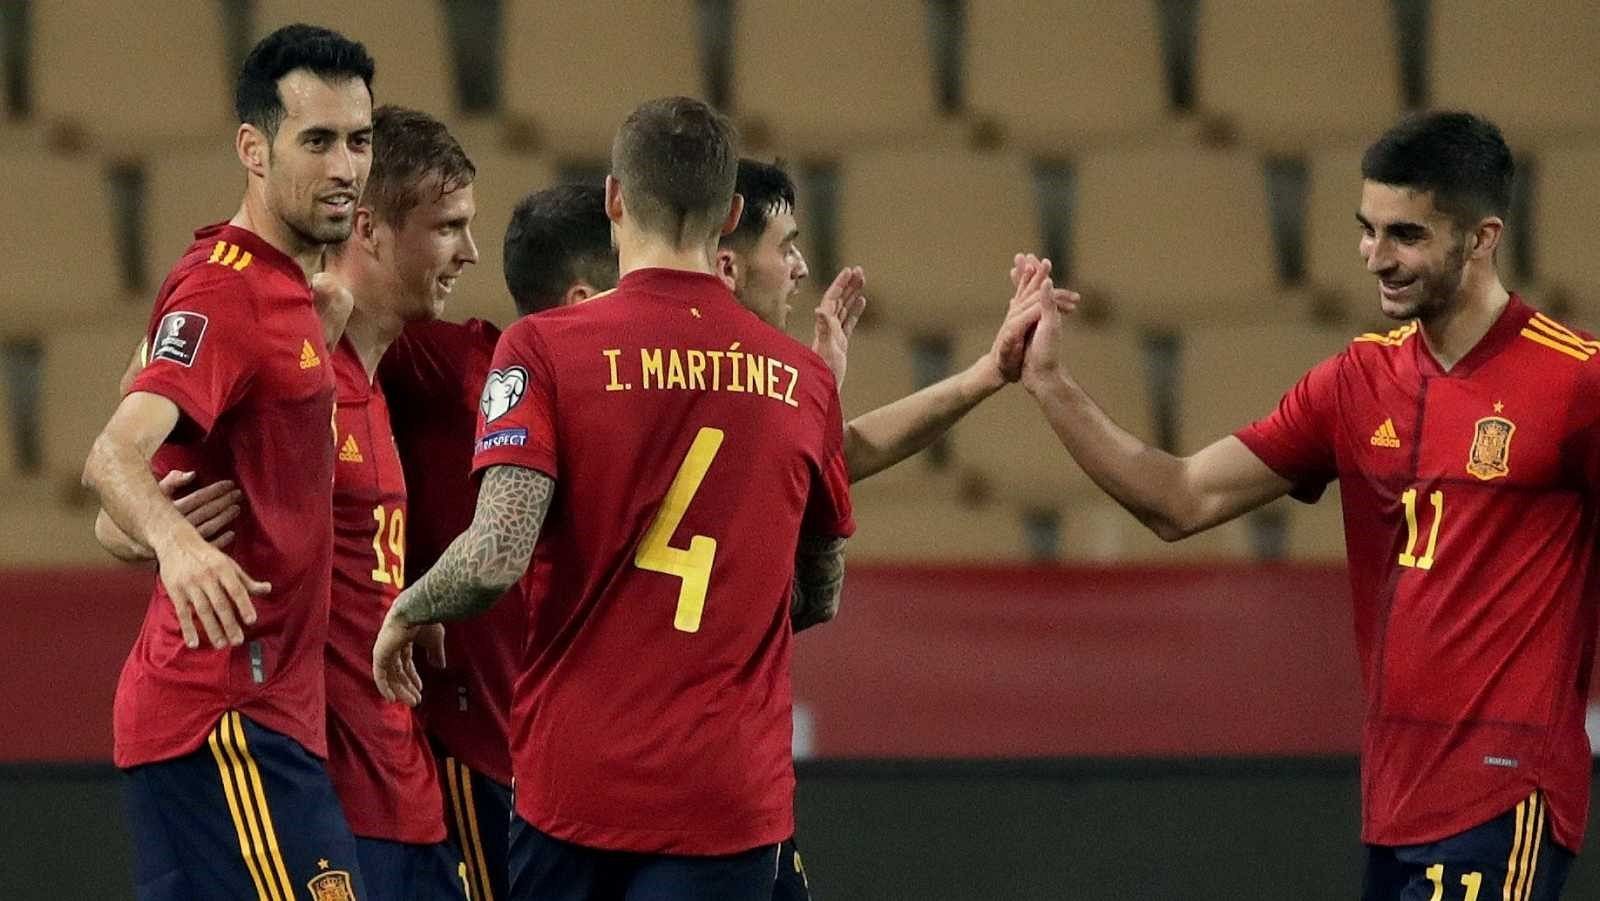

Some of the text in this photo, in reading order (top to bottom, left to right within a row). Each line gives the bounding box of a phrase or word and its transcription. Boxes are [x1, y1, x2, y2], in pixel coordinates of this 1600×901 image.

[603, 342, 799, 408] I. MARTÍNEZ
[1370, 436, 1400, 448] adidas
[372, 505, 404, 588] 19
[634, 426, 724, 633] 4
[1398, 488, 1443, 570] 11
